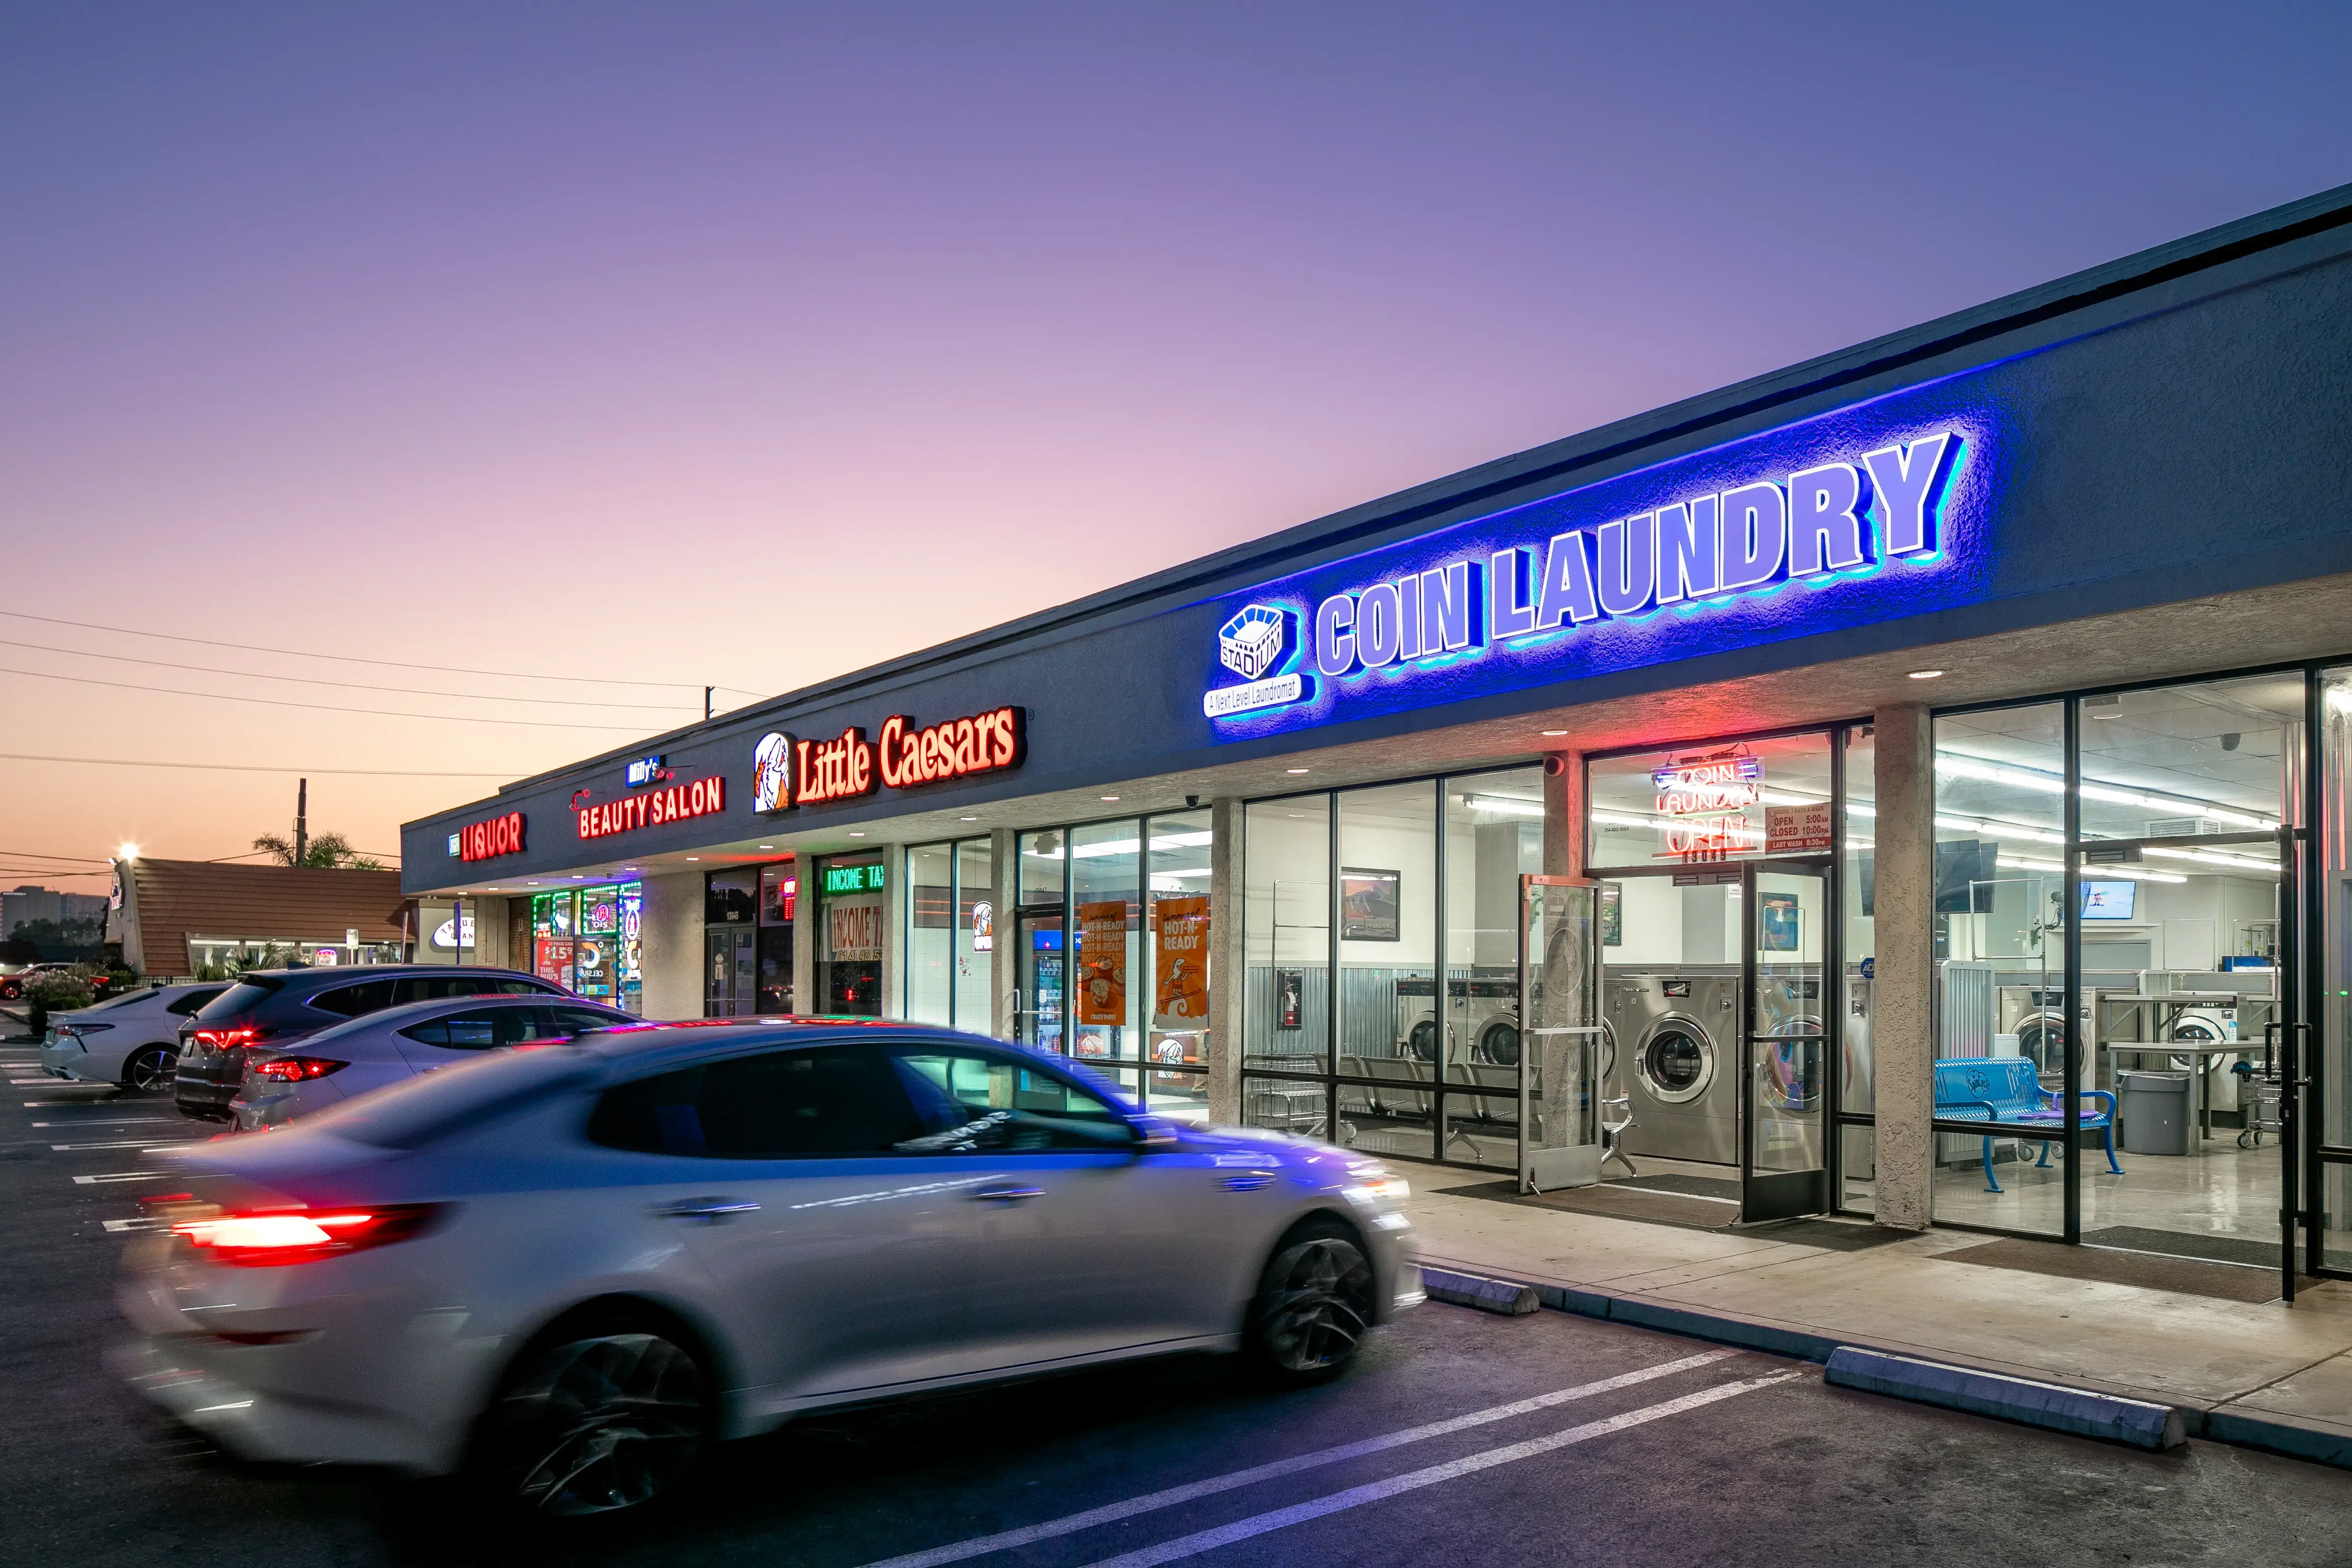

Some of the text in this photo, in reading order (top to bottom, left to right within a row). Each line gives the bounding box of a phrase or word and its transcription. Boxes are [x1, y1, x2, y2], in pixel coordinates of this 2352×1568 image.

[1316, 431, 1954, 676] COIN LAUNDRY
[1222, 631, 1280, 676] STADIUM
[1209, 678, 1295, 712] A Next Level Laundromat
[796, 707, 1014, 803] Little Caesars
[629, 758, 658, 783] Milly's
[1677, 764, 1734, 787] COIN
[579, 775, 720, 839] BEAUTY SALON
[1770, 827, 1798, 837] CLOSED
[1774, 816, 1793, 826] OPEN
[462, 812, 520, 862] LIQUOR
[1667, 816, 1744, 852] OPEN
[1684, 851, 1726, 864] 13049
[827, 867, 863, 891] INCOME
[833, 906, 870, 948] INCOME
[1110, 911, 1117, 921] of
[1162, 911, 1190, 922] Summer
[1164, 936, 1198, 950] READY
[1863, 963, 1874, 971] AD
